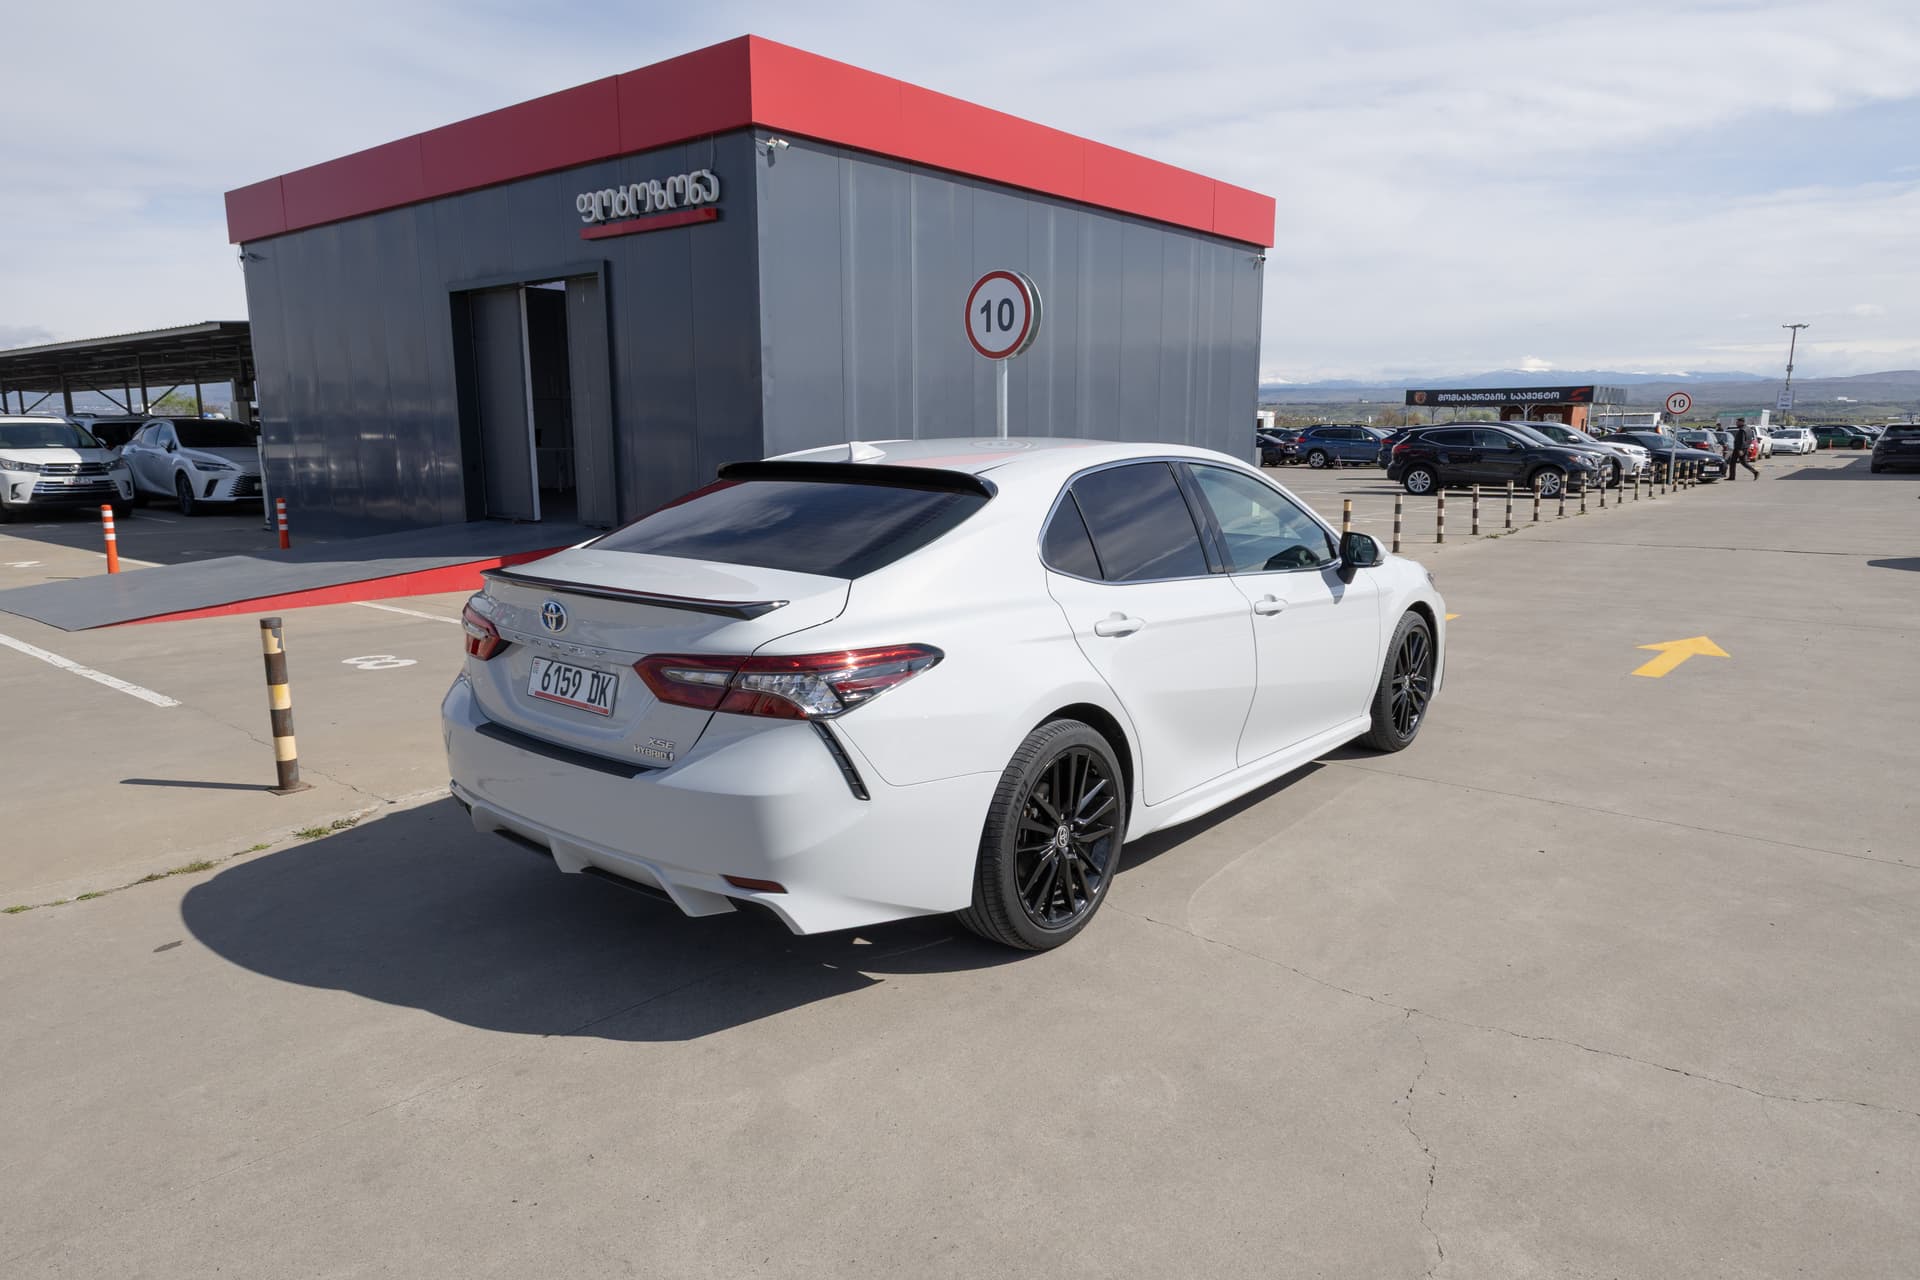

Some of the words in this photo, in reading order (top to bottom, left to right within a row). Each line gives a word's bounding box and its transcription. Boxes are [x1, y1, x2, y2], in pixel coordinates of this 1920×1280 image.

[981, 298, 1015, 333] 10
[1671, 399, 1686, 408] 10
[541, 661, 582, 698] 6159
[587, 672, 612, 707] DK
[649, 736, 674, 749] XSE
[633, 745, 667, 760] HYBRID
